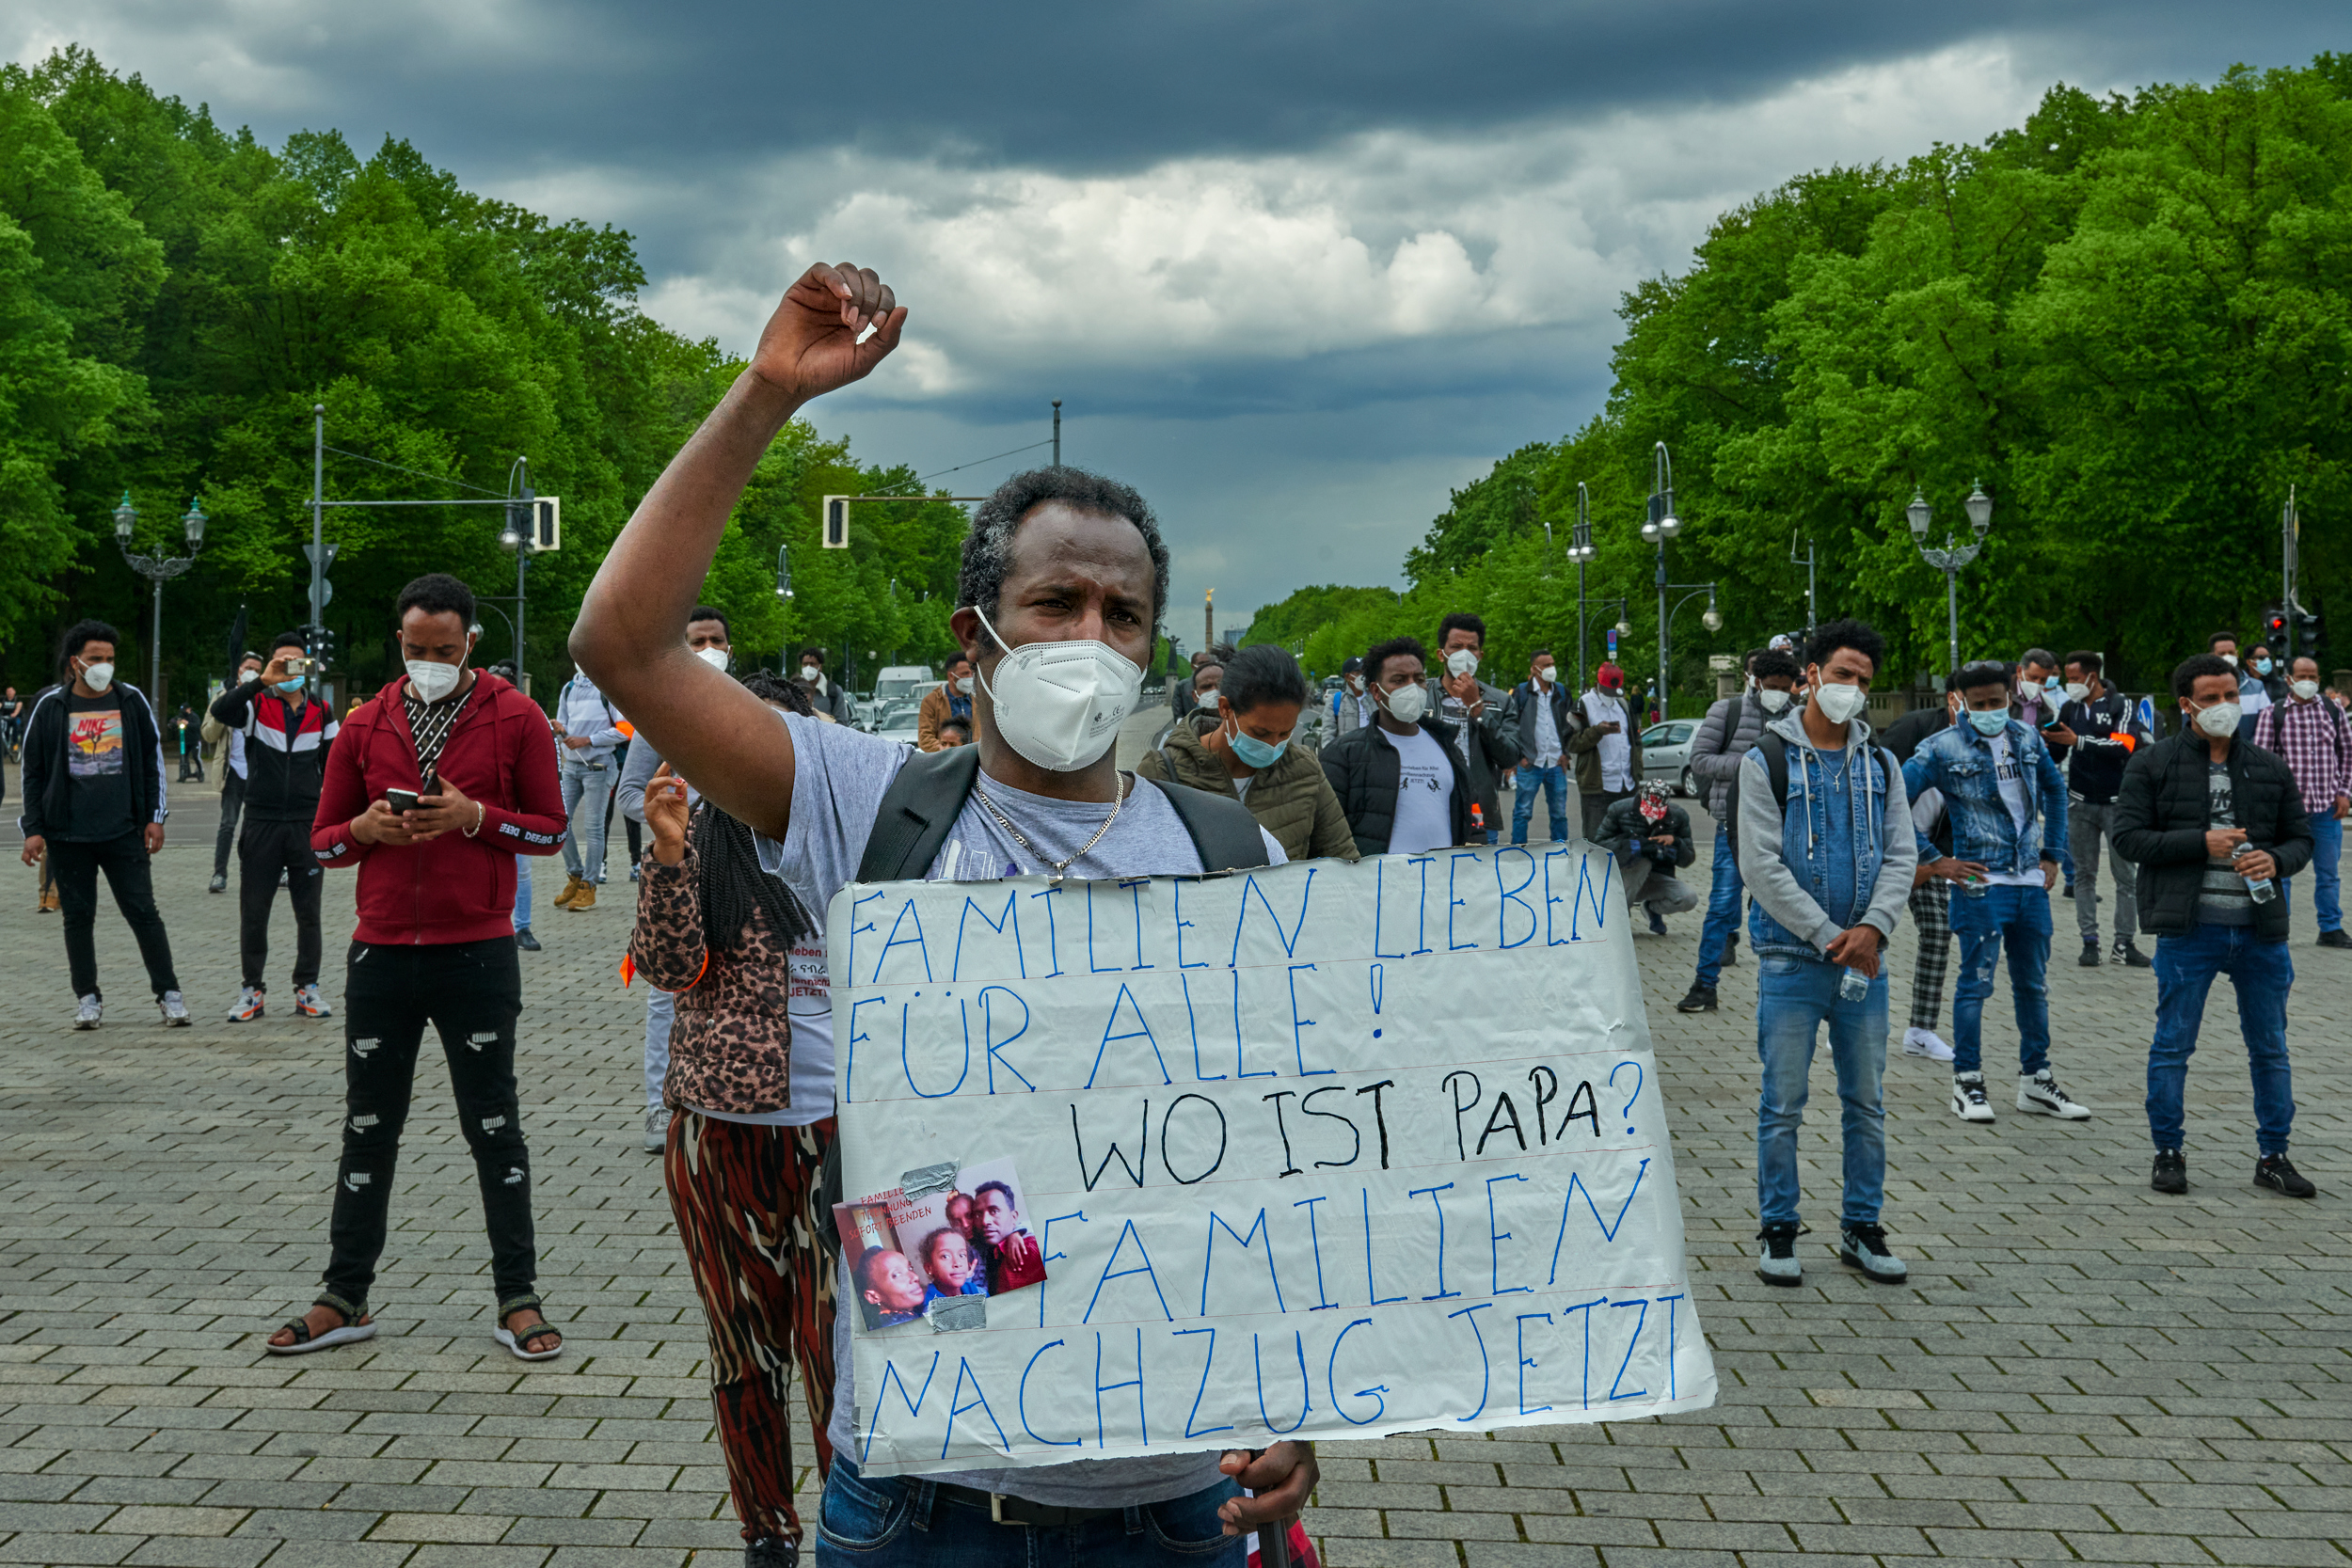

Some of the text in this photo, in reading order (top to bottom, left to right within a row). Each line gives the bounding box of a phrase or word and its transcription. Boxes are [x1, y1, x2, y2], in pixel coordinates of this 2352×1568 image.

[77, 718, 107, 733] NIKE
[849, 847, 1613, 988] FAMILIEN LIEBEN
[848, 986, 1036, 1103] FÜR
[1070, 1093, 1227, 1192] WO
[1262, 1080, 1395, 1179] IST
[849, 1206, 931, 1241] SOFORT BEENDEN
[861, 1198, 913, 1221] TRENNUNG
[1040, 1158, 1651, 1329] FAMILIEN
[863, 1292, 1685, 1463] NACHZUG JETZT
